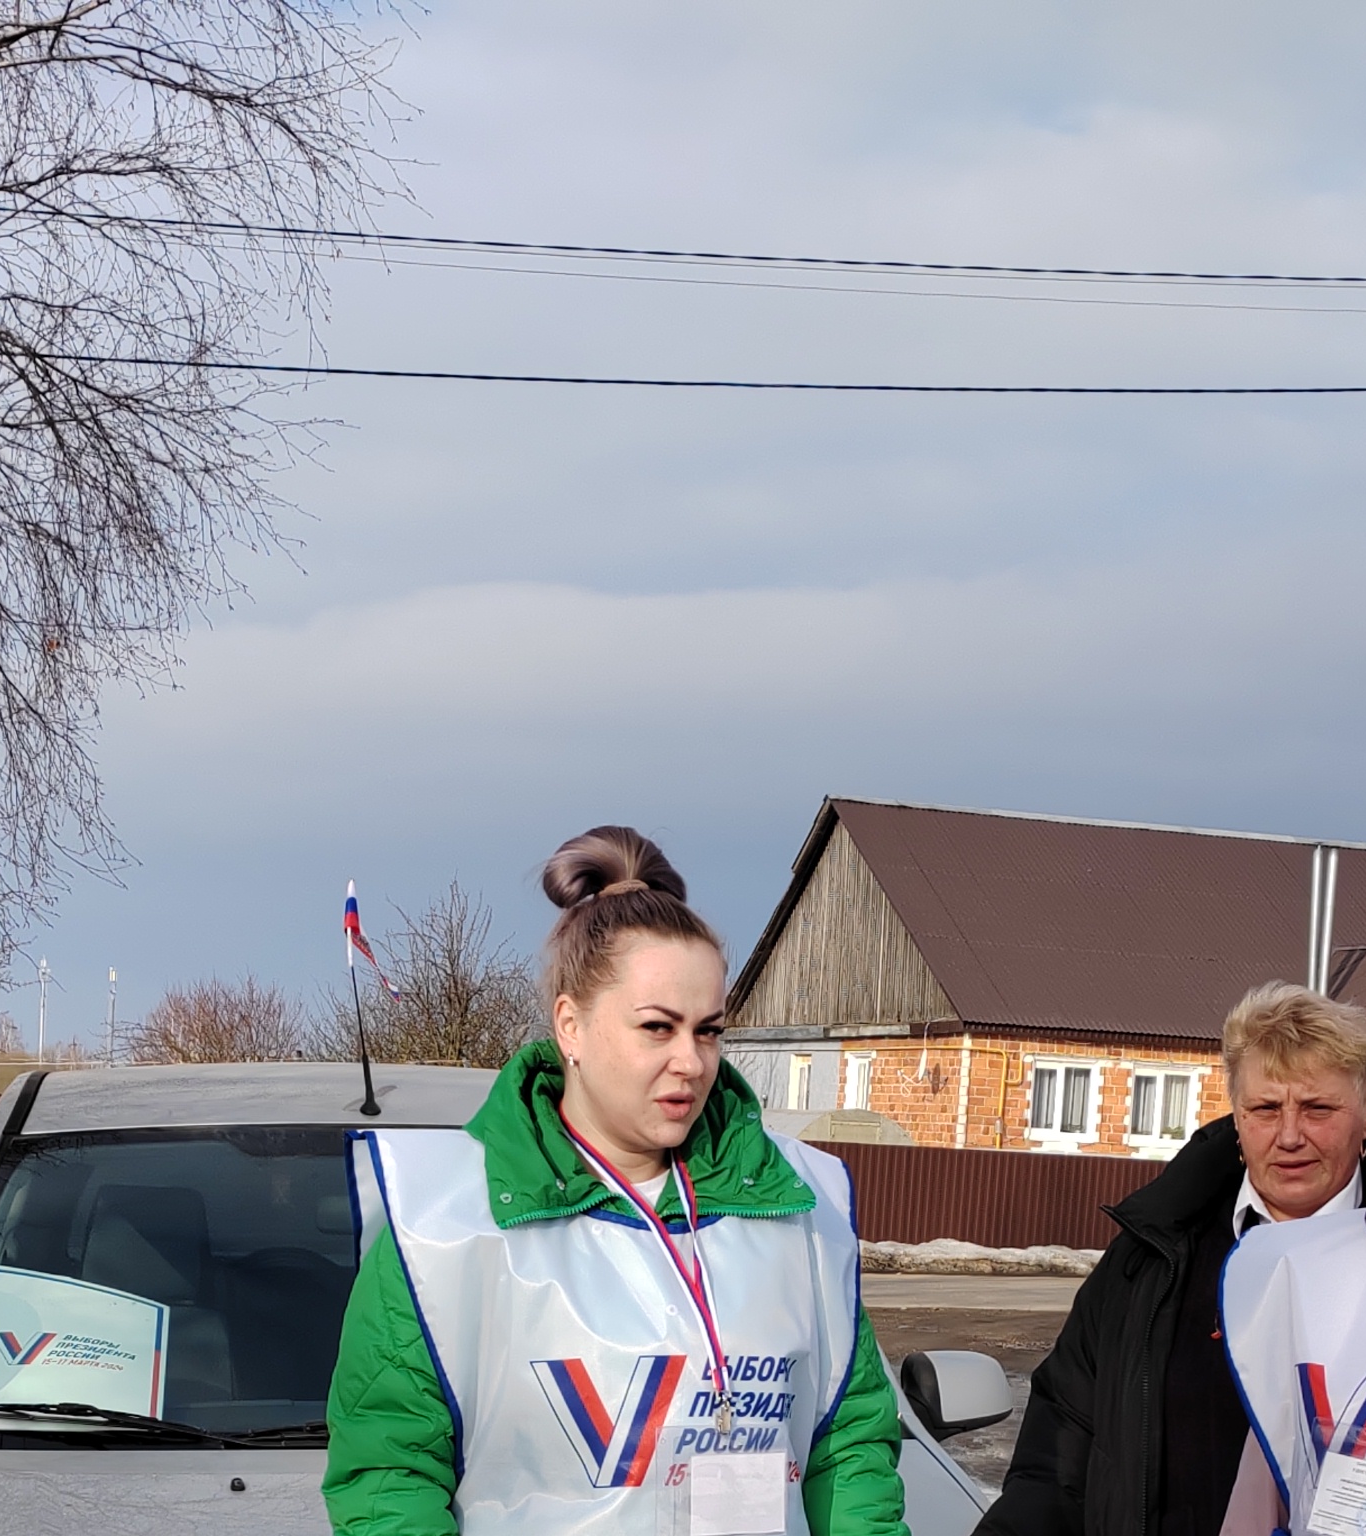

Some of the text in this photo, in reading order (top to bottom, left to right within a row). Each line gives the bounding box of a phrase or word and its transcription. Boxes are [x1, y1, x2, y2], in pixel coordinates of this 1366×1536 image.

[63, 1334, 121, 1349] ВЫБОРЫ
[47, 1350, 101, 1360] РОССИИ
[55, 1341, 137, 1361] ПРЕЗИДЕНТА
[68, 1359, 100, 1368] МАРТА
[675, 1427, 779, 1455] РОССИИ
